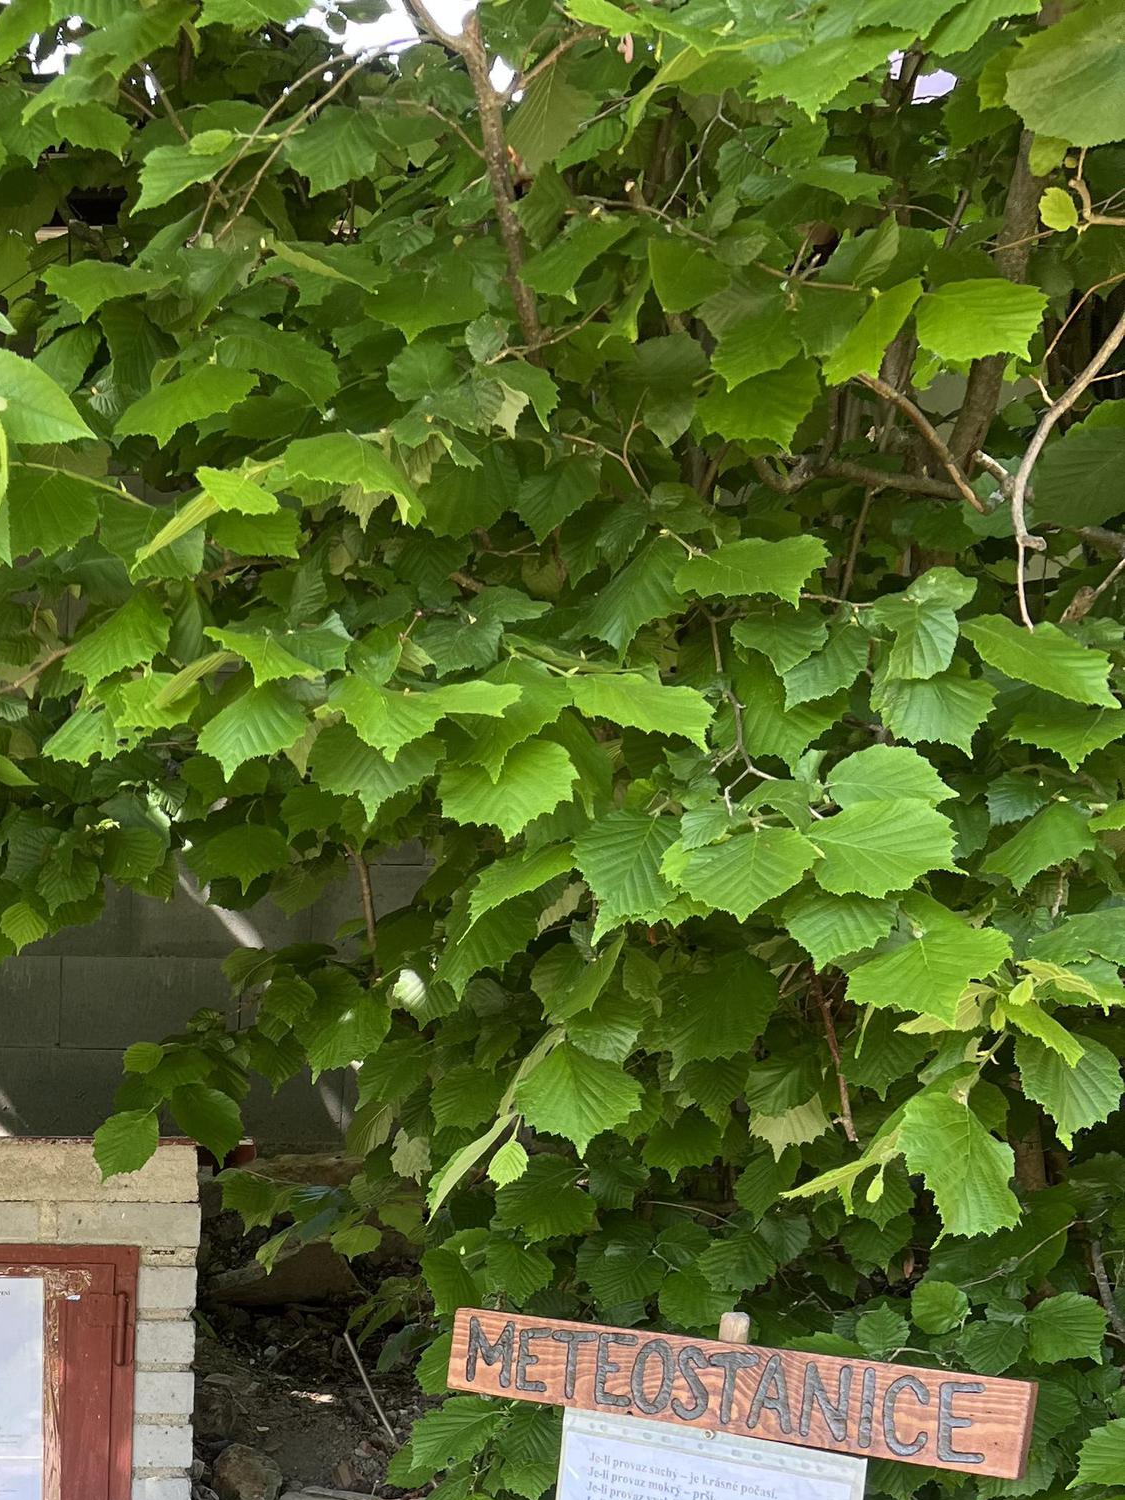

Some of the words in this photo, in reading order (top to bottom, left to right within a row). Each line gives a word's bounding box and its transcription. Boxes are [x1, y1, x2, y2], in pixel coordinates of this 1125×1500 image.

[466, 1315, 986, 1464] METEOSTANICE
[586, 1481, 608, 1495] Je-li
[587, 1466, 609, 1480] Je-li
[611, 1473, 646, 1488] provaz
[648, 1481, 681, 1497] mokrý
[589, 1452, 611, 1465] Je-li
[612, 1459, 648, 1473] provaz
[702, 1474, 739, 1491] krásné
[740, 1485, 778, 1499] počasí.
